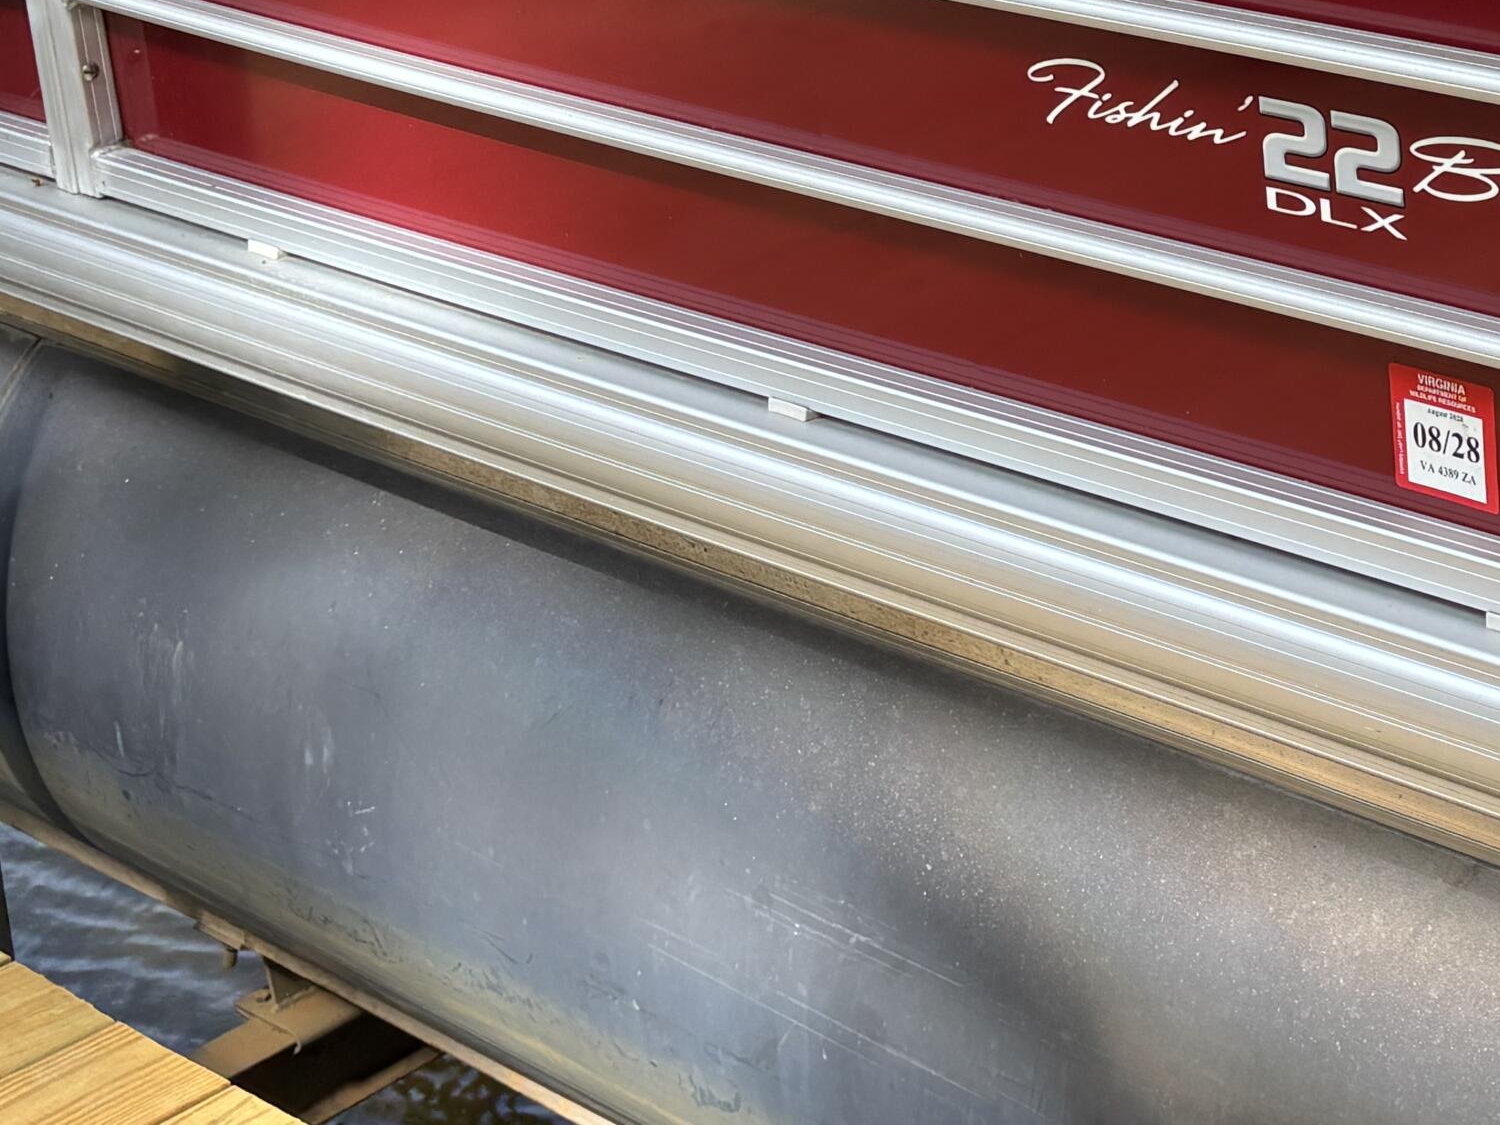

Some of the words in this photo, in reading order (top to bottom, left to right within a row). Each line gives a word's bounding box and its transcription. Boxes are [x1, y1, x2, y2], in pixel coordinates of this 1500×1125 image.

[1027, 57, 1255, 145] Fishin'
[1257, 94, 1406, 208] 22
[1264, 185, 1408, 241] DLX
[1417, 373, 1466, 395] VIRGINIA
[1413, 421, 1481, 463] 08/28
[1420, 459, 1435, 474] VA
[1438, 465, 1459, 480] 4389
[1461, 471, 1477, 486] ZA
